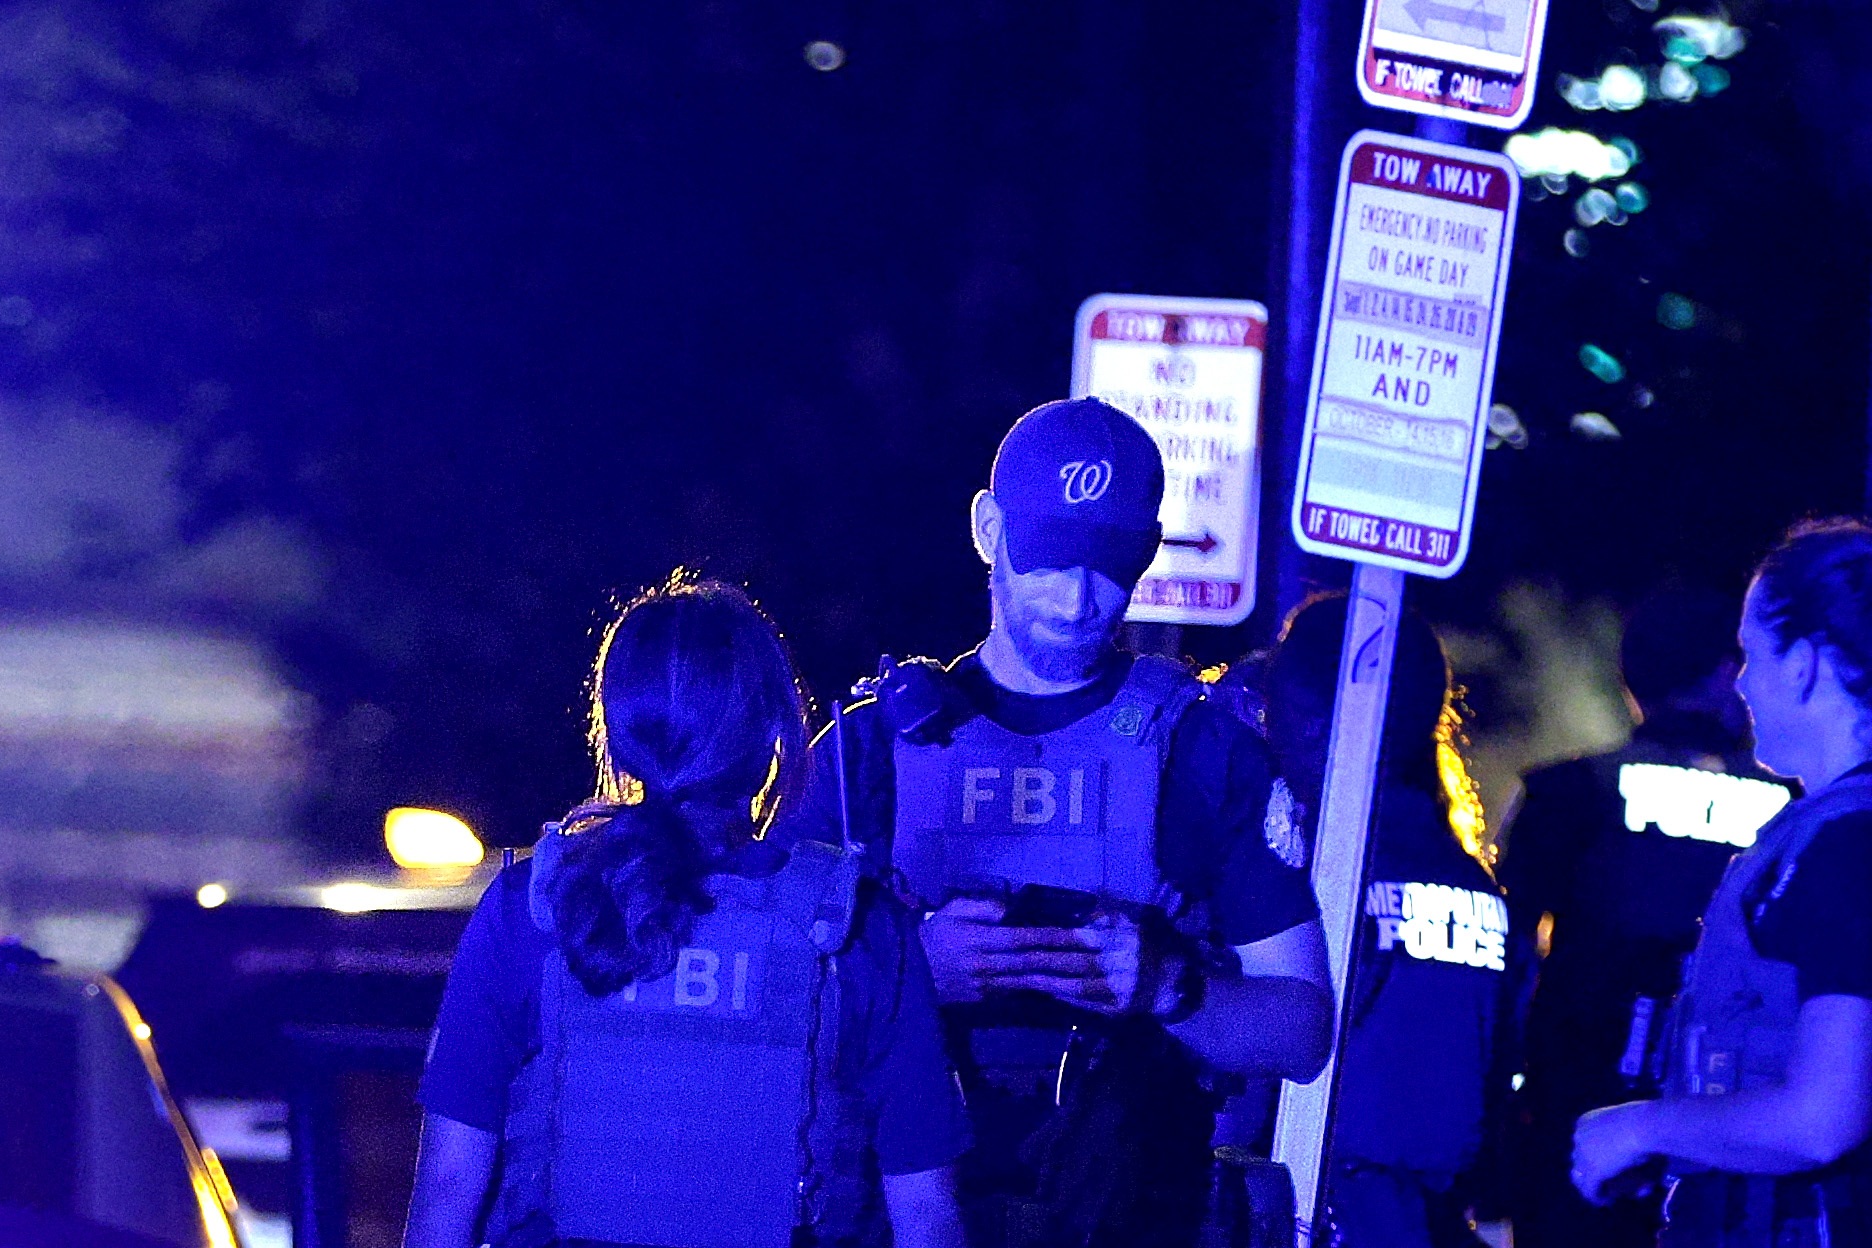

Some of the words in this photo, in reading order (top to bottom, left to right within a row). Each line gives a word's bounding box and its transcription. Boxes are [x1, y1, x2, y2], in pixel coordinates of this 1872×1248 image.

[1375, 58, 1392, 86] IF
[1450, 72, 1484, 104] CALL
[1372, 151, 1420, 185] TOW
[1426, 164, 1492, 200] AWAY
[1359, 203, 1422, 241] EMERGENCY
[1443, 219, 1489, 254] PARKING
[1368, 245, 1390, 272] ON
[1393, 251, 1434, 281] GAME
[1439, 258, 1470, 289] DAY
[1354, 334, 1459, 379] 11AM-7PM
[1372, 373, 1431, 407] AND
[1308, 507, 1327, 534] IF
[1329, 511, 1380, 546] TOWED
[1385, 525, 1422, 555] CALL
[1425, 535, 1451, 560] 311
[961, 767, 1084, 825] FBI
[1377, 917, 1507, 972] POLICE
[626, 948, 749, 1011] BI
